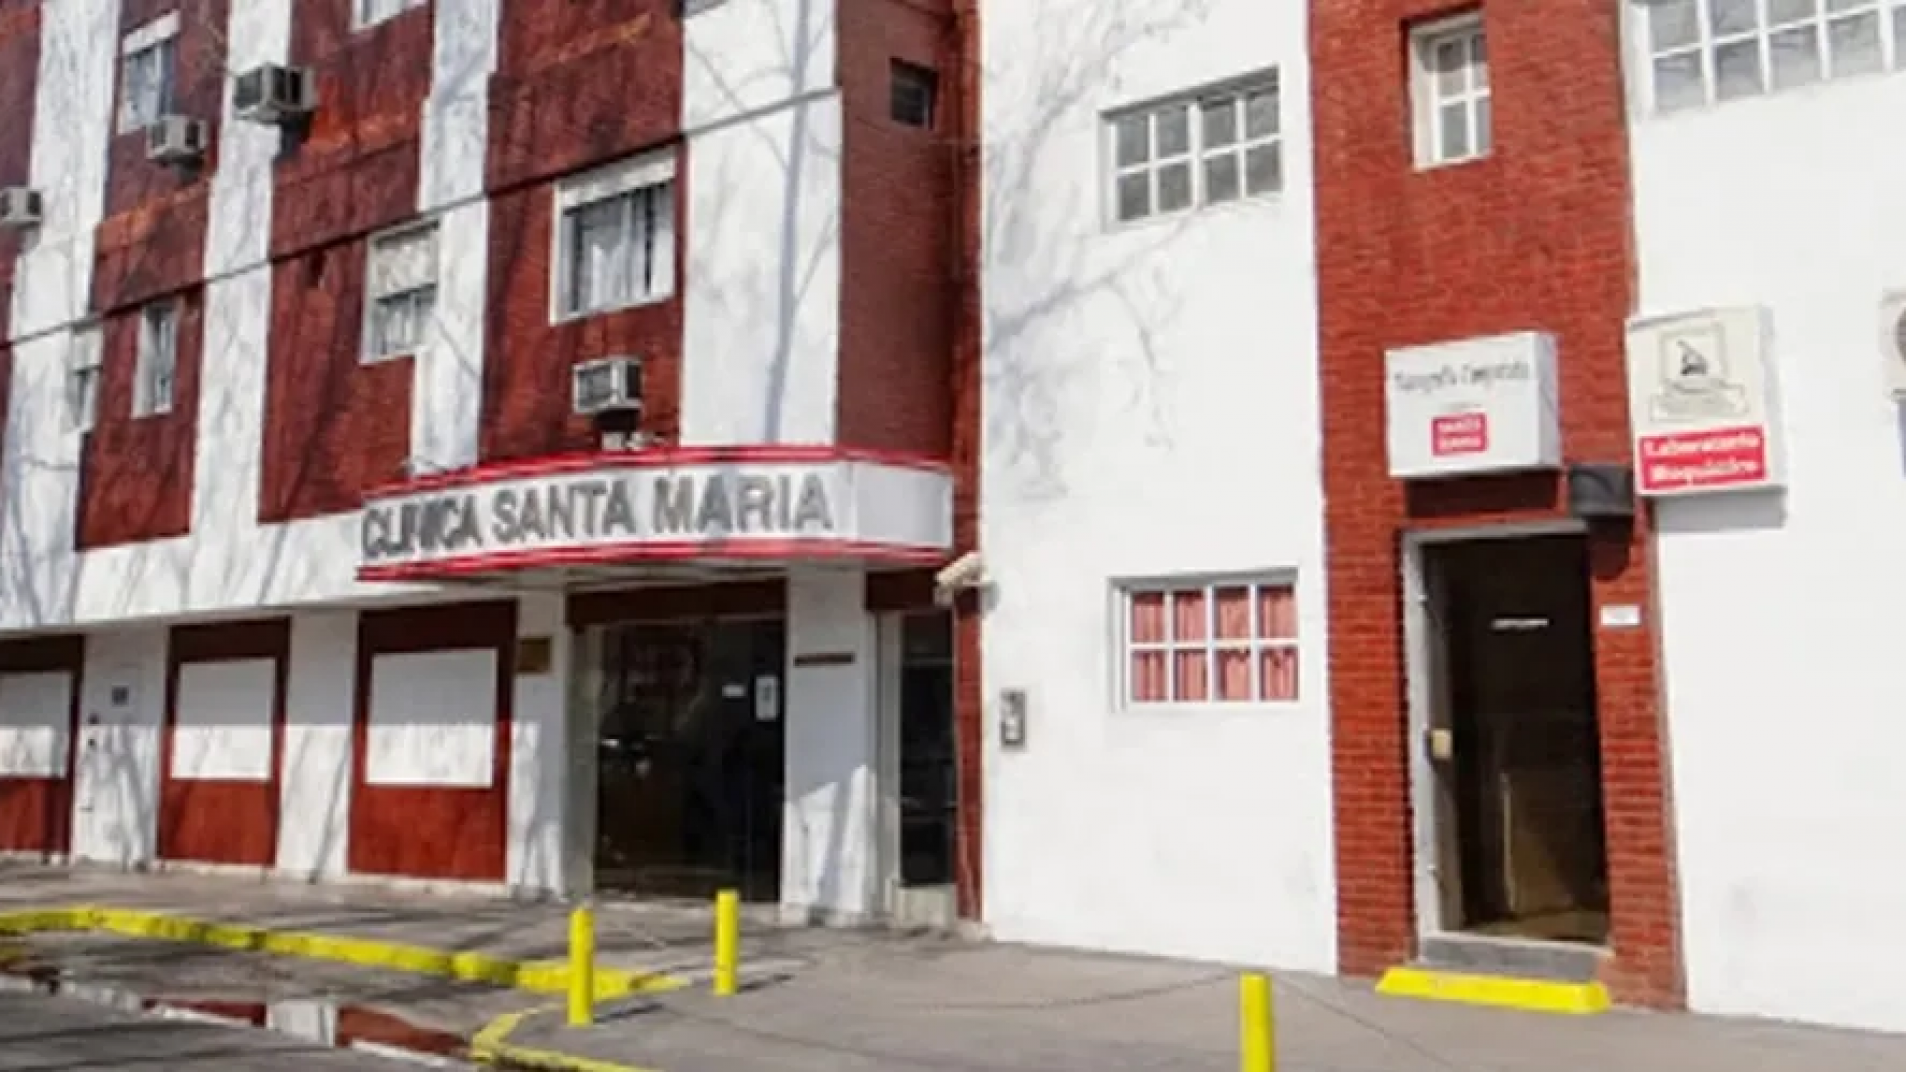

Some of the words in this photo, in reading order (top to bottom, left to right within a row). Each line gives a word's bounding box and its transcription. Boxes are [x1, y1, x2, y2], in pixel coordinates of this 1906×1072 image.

[362, 495, 484, 558] CLINICA
[492, 478, 636, 543] SANTA
[653, 474, 834, 534] MARIA
